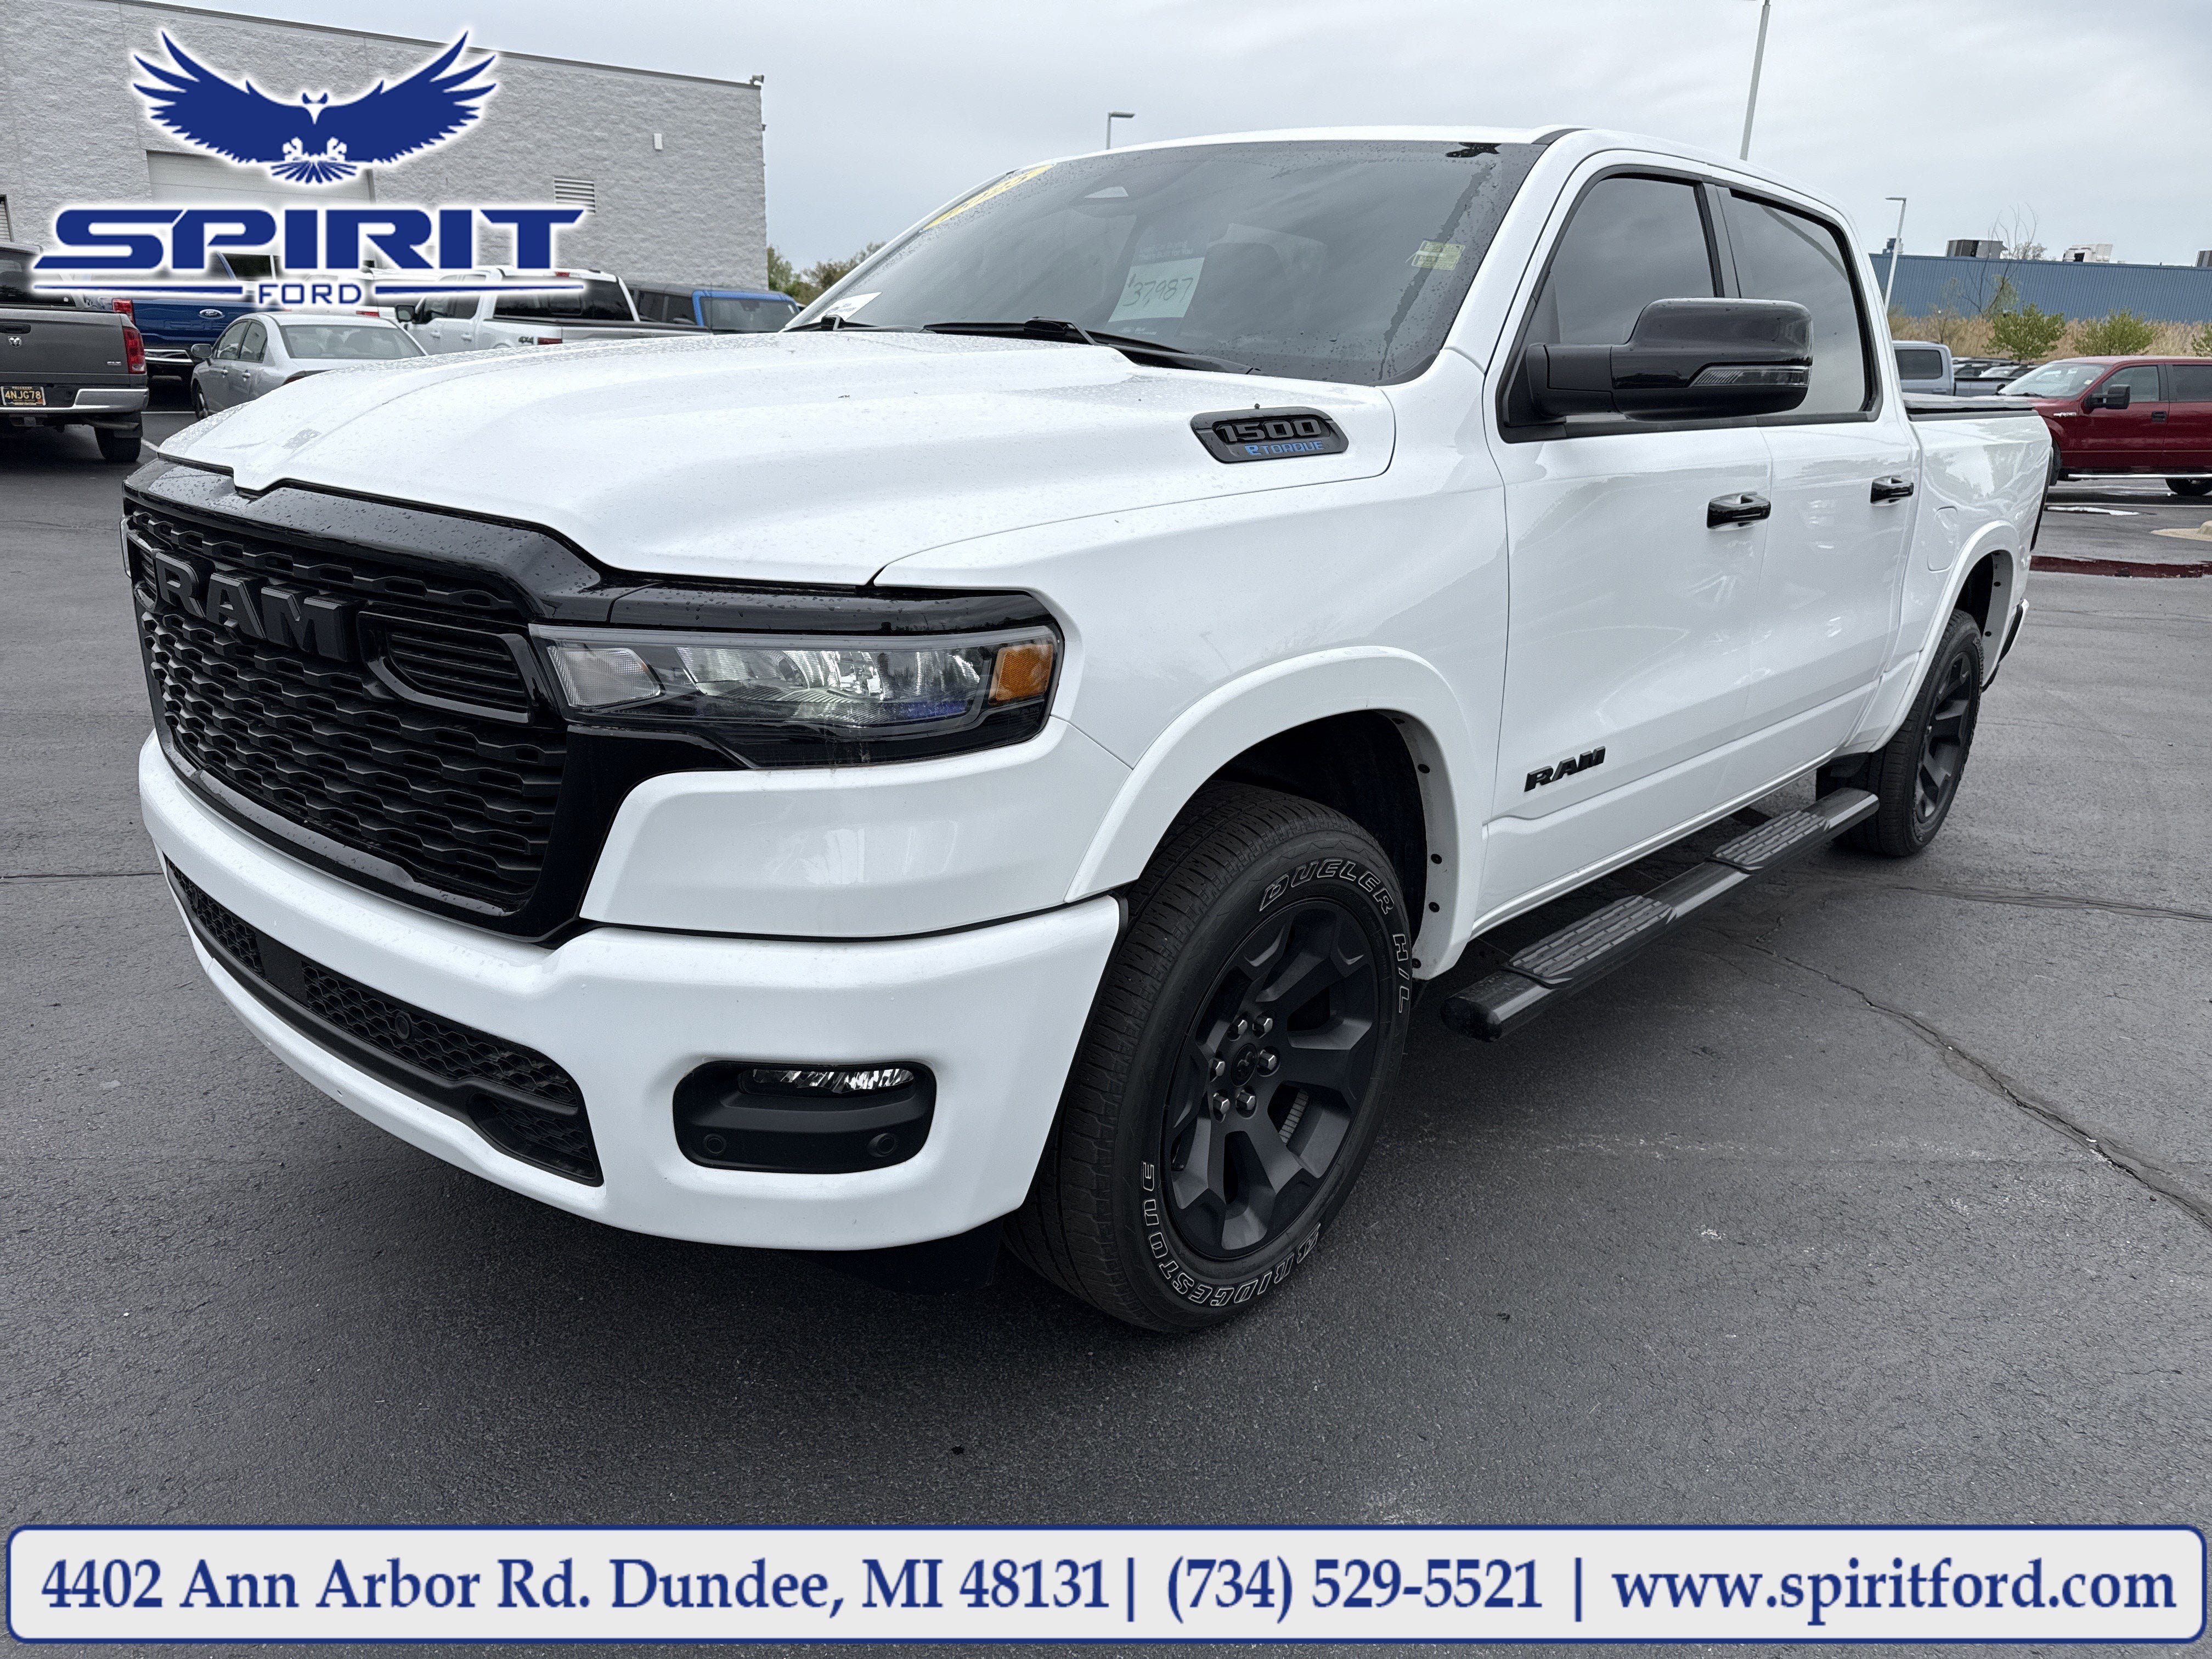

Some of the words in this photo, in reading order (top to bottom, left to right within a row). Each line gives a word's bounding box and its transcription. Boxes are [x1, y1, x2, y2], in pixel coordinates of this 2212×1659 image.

[4, 390, 42, 399] 4NJG78
[1215, 419, 1322, 443] 1500
[155, 550, 359, 662] RAM
[1524, 746, 1606, 792] RAM
[1259, 859, 1395, 915] DUELER
[1392, 934, 1410, 1014] H/L
[1141, 1161, 1321, 1307] BRIDGESTONE
